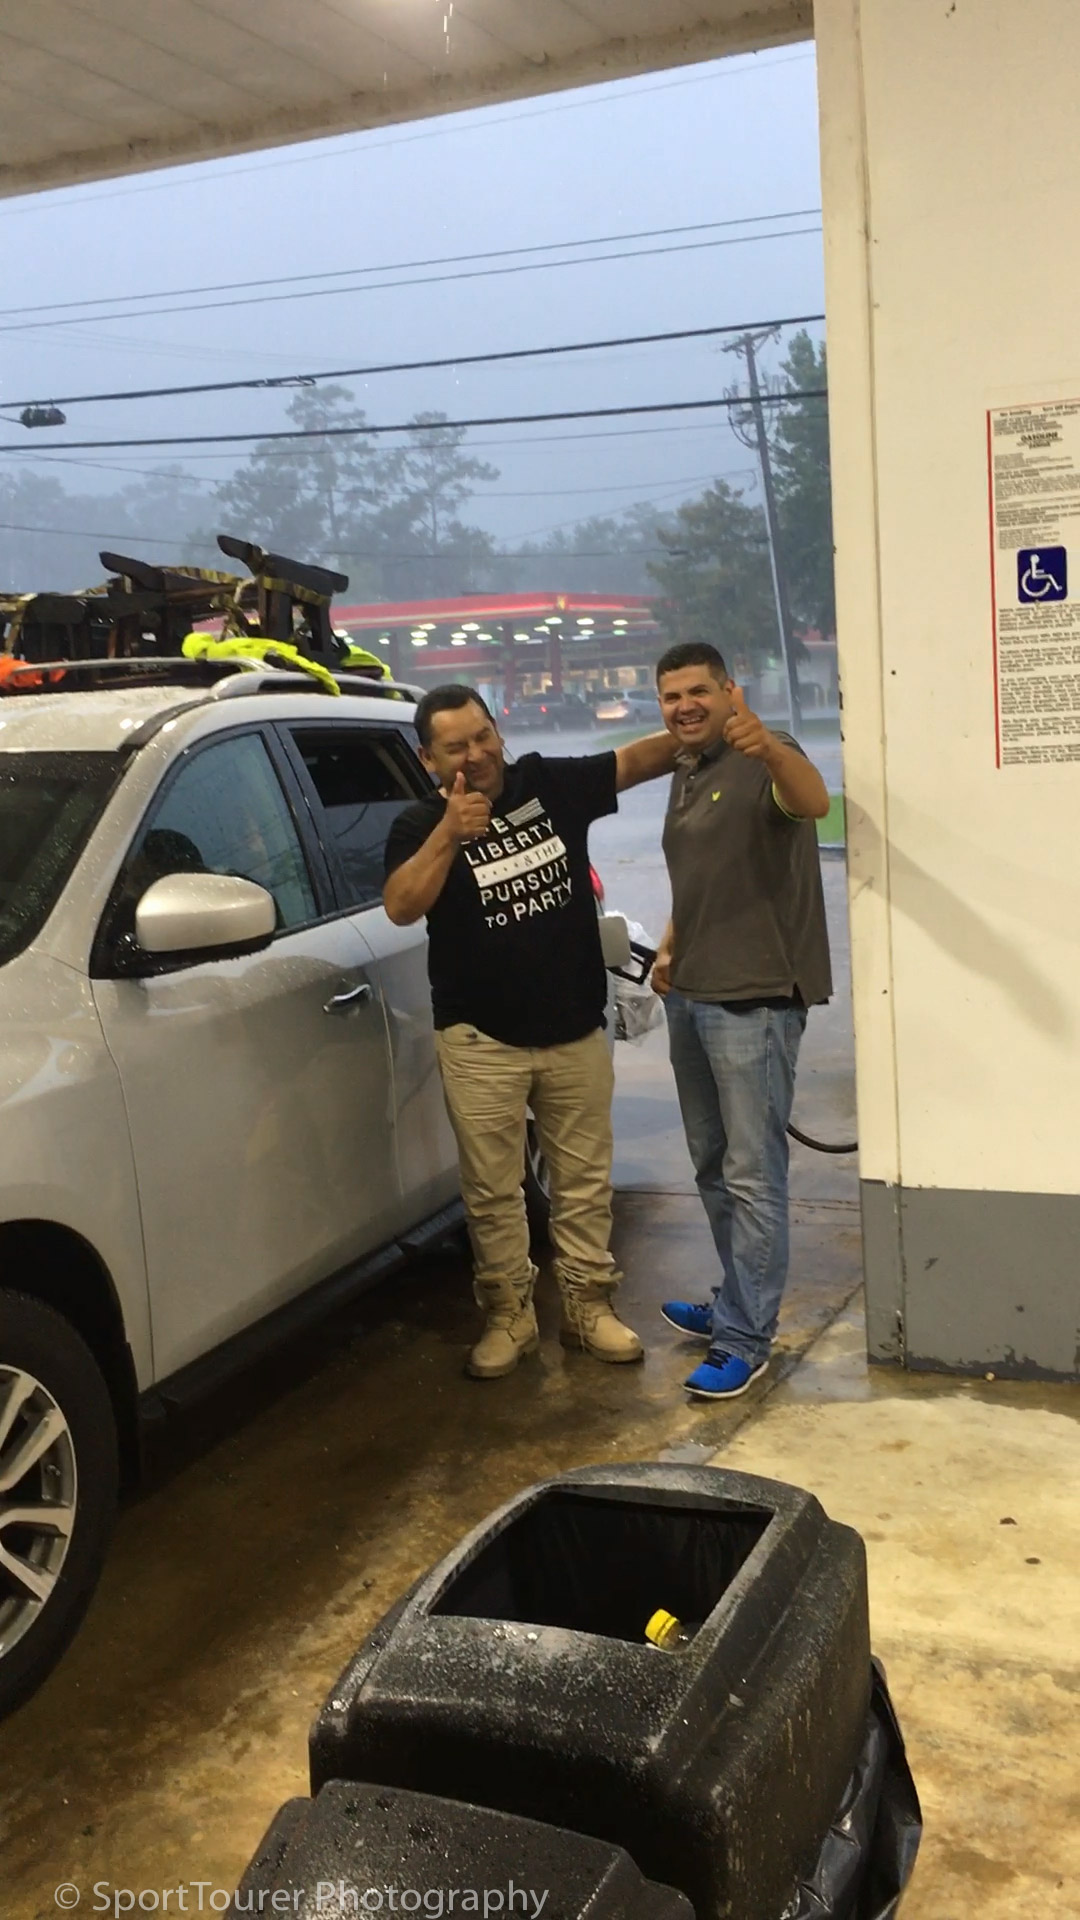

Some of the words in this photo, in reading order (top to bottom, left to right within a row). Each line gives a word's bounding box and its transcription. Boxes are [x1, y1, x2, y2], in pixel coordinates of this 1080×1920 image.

[464, 818, 554, 866] LIBERTY
[524, 856, 533, 867] &
[535, 841, 560, 862] THE
[480, 855, 569, 907] PURSUIT
[484, 912, 508, 929] TO
[511, 877, 572, 922] PARTY
